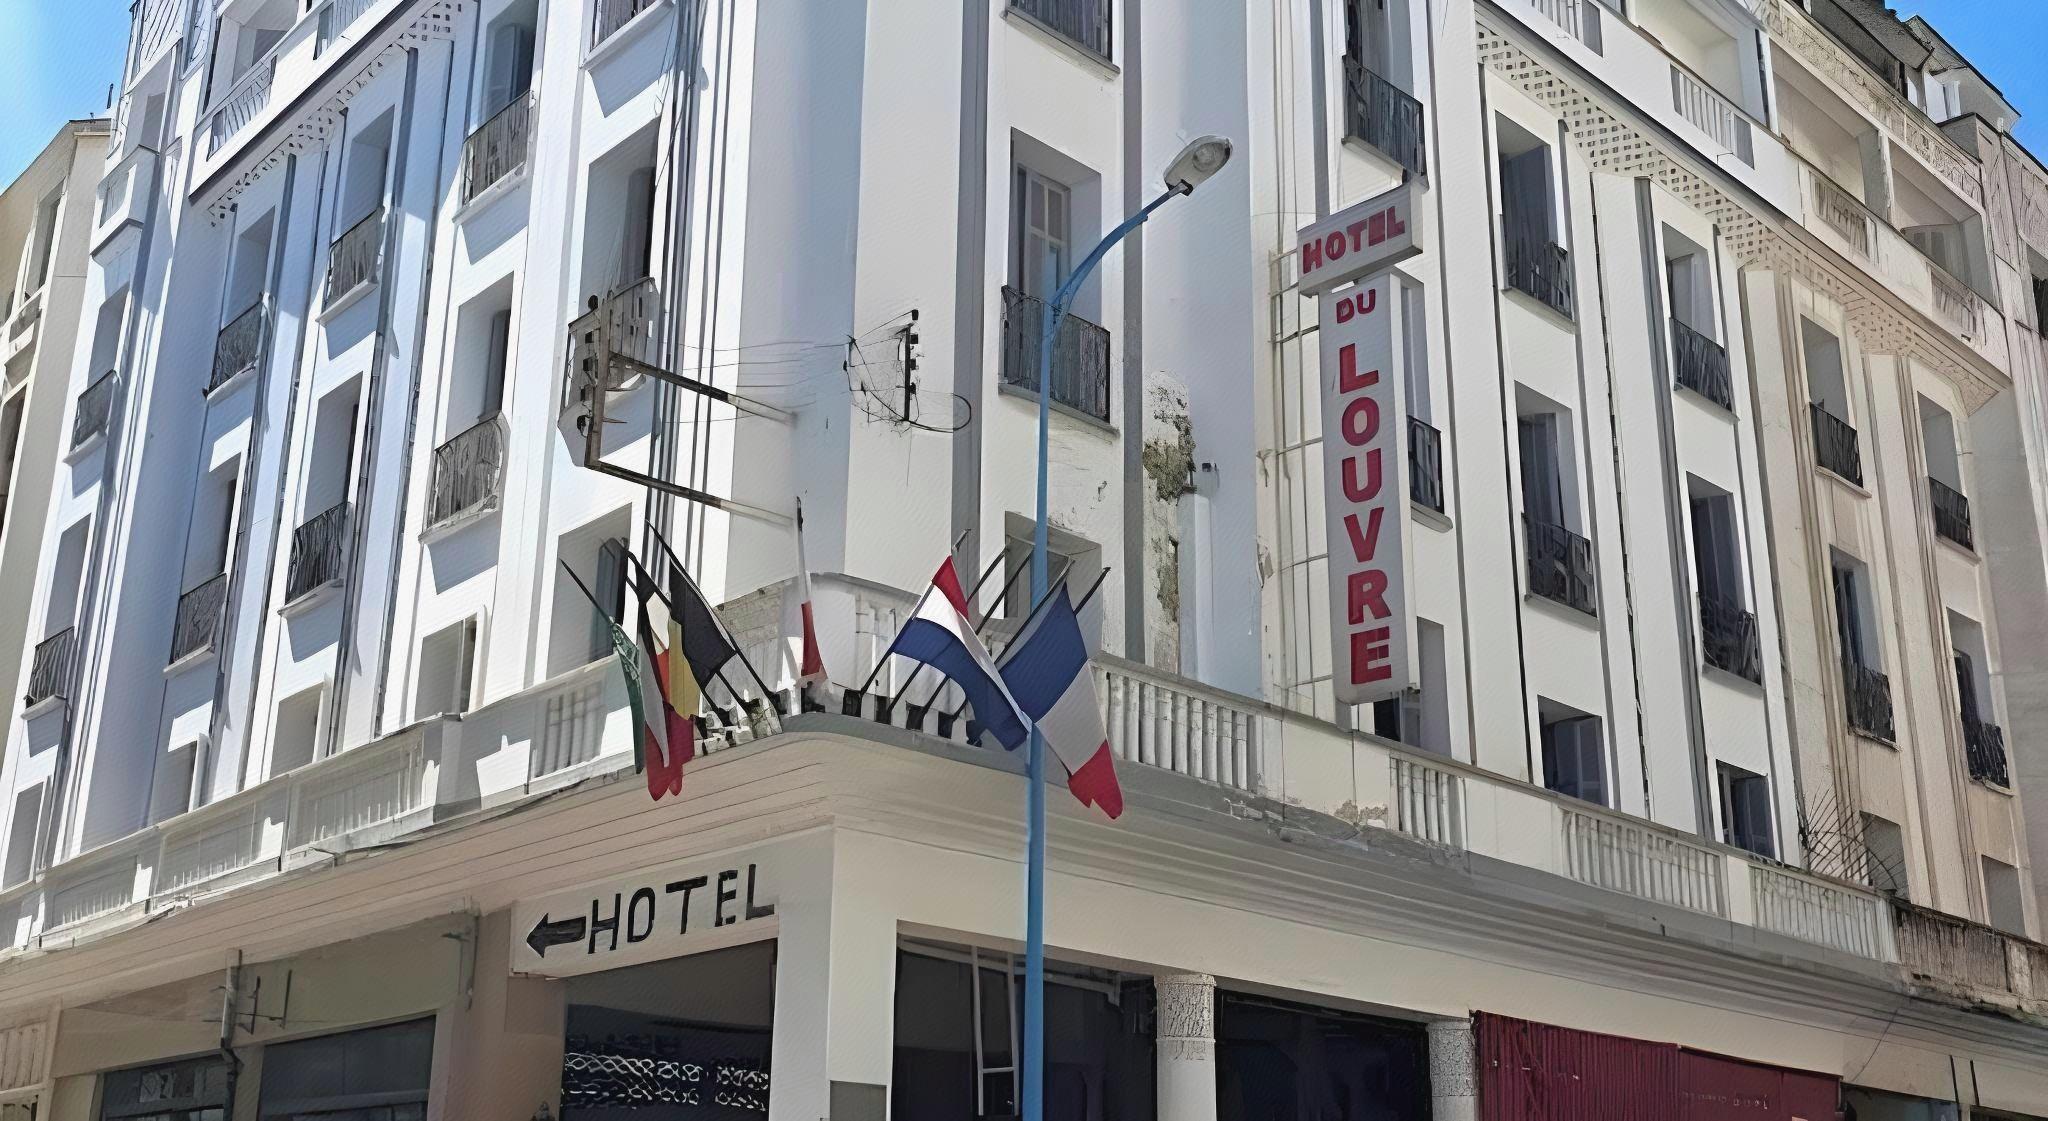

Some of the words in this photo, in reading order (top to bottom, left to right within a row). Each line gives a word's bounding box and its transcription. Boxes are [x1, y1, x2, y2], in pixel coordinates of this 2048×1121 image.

[1302, 206, 1405, 274] HOTEL
[1336, 289, 1376, 324] DU
[1339, 343, 1392, 685] LOUVRE
[587, 863, 775, 954] HOTEL
